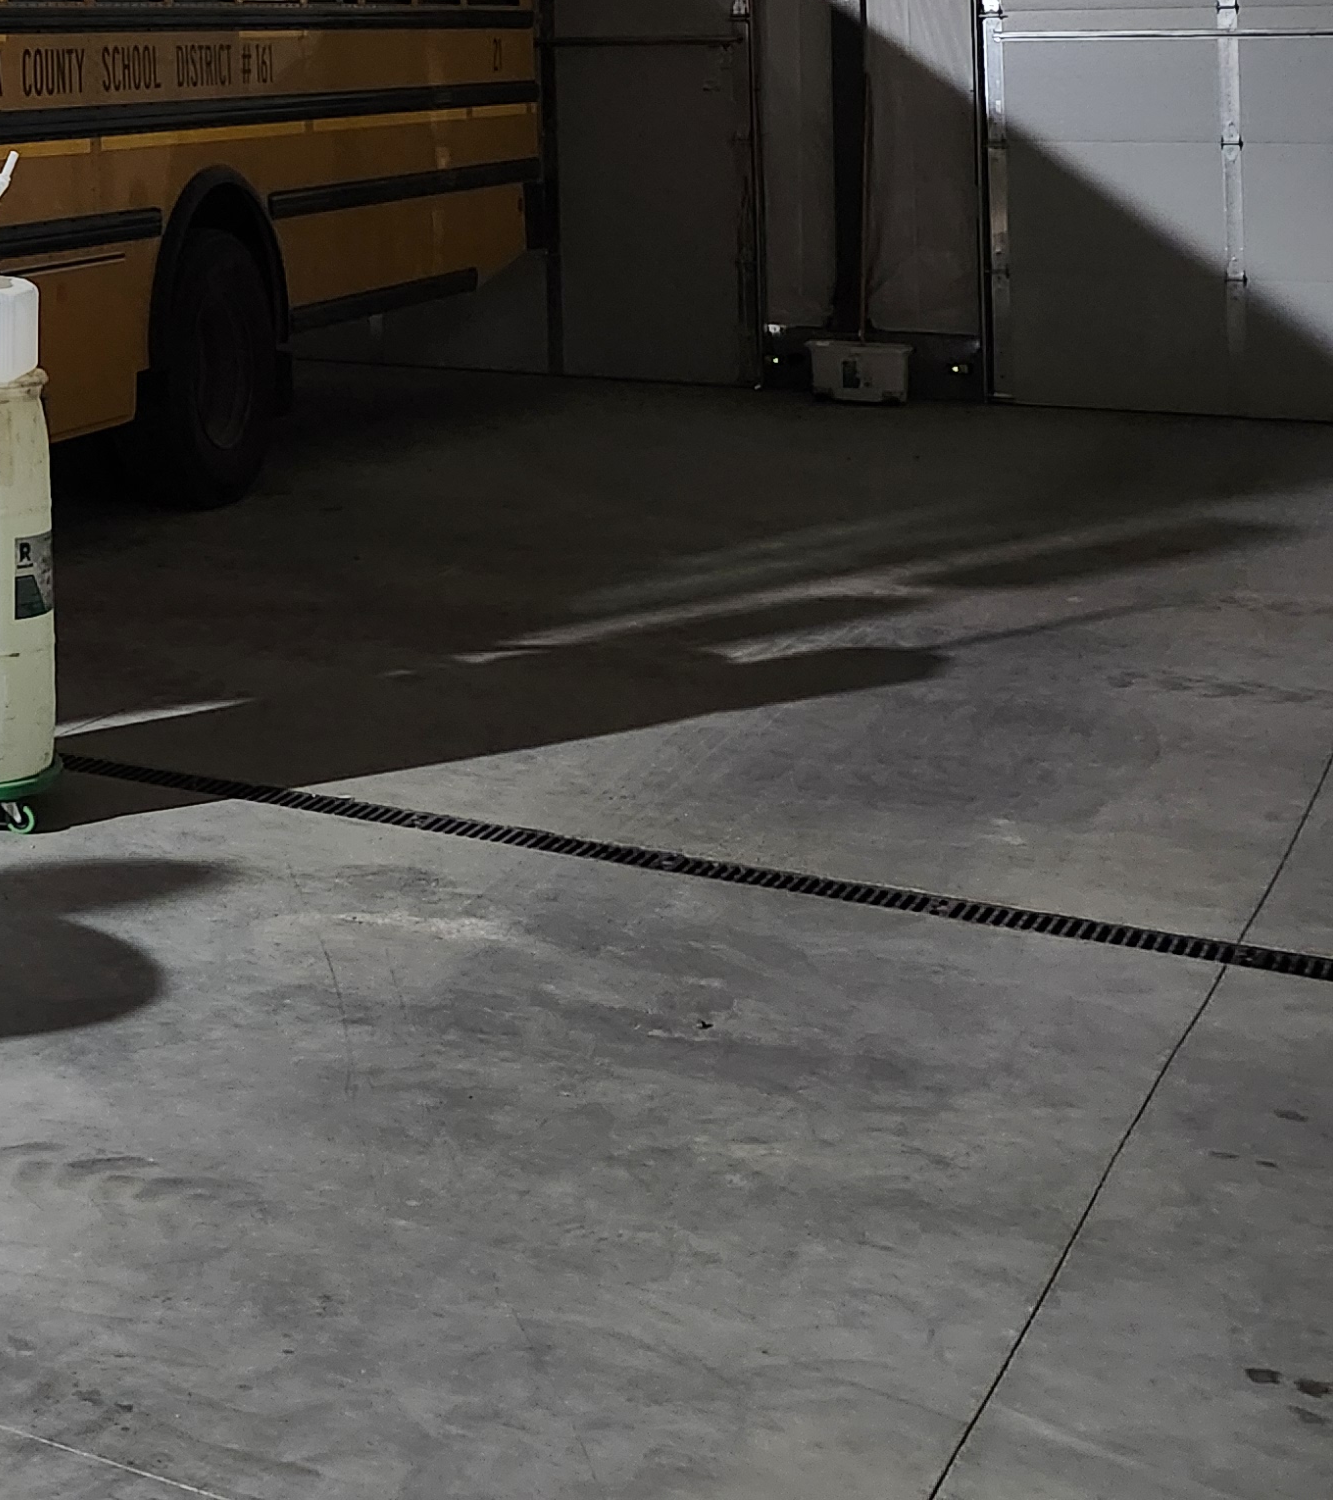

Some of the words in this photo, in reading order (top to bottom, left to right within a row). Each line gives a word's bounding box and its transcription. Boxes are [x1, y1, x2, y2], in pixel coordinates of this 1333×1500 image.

[22, 48, 84, 97] COUNTY
[101, 45, 162, 92] SCHOOL
[175, 43, 232, 88] DISTRICT
[493, 38, 503, 72] 21
